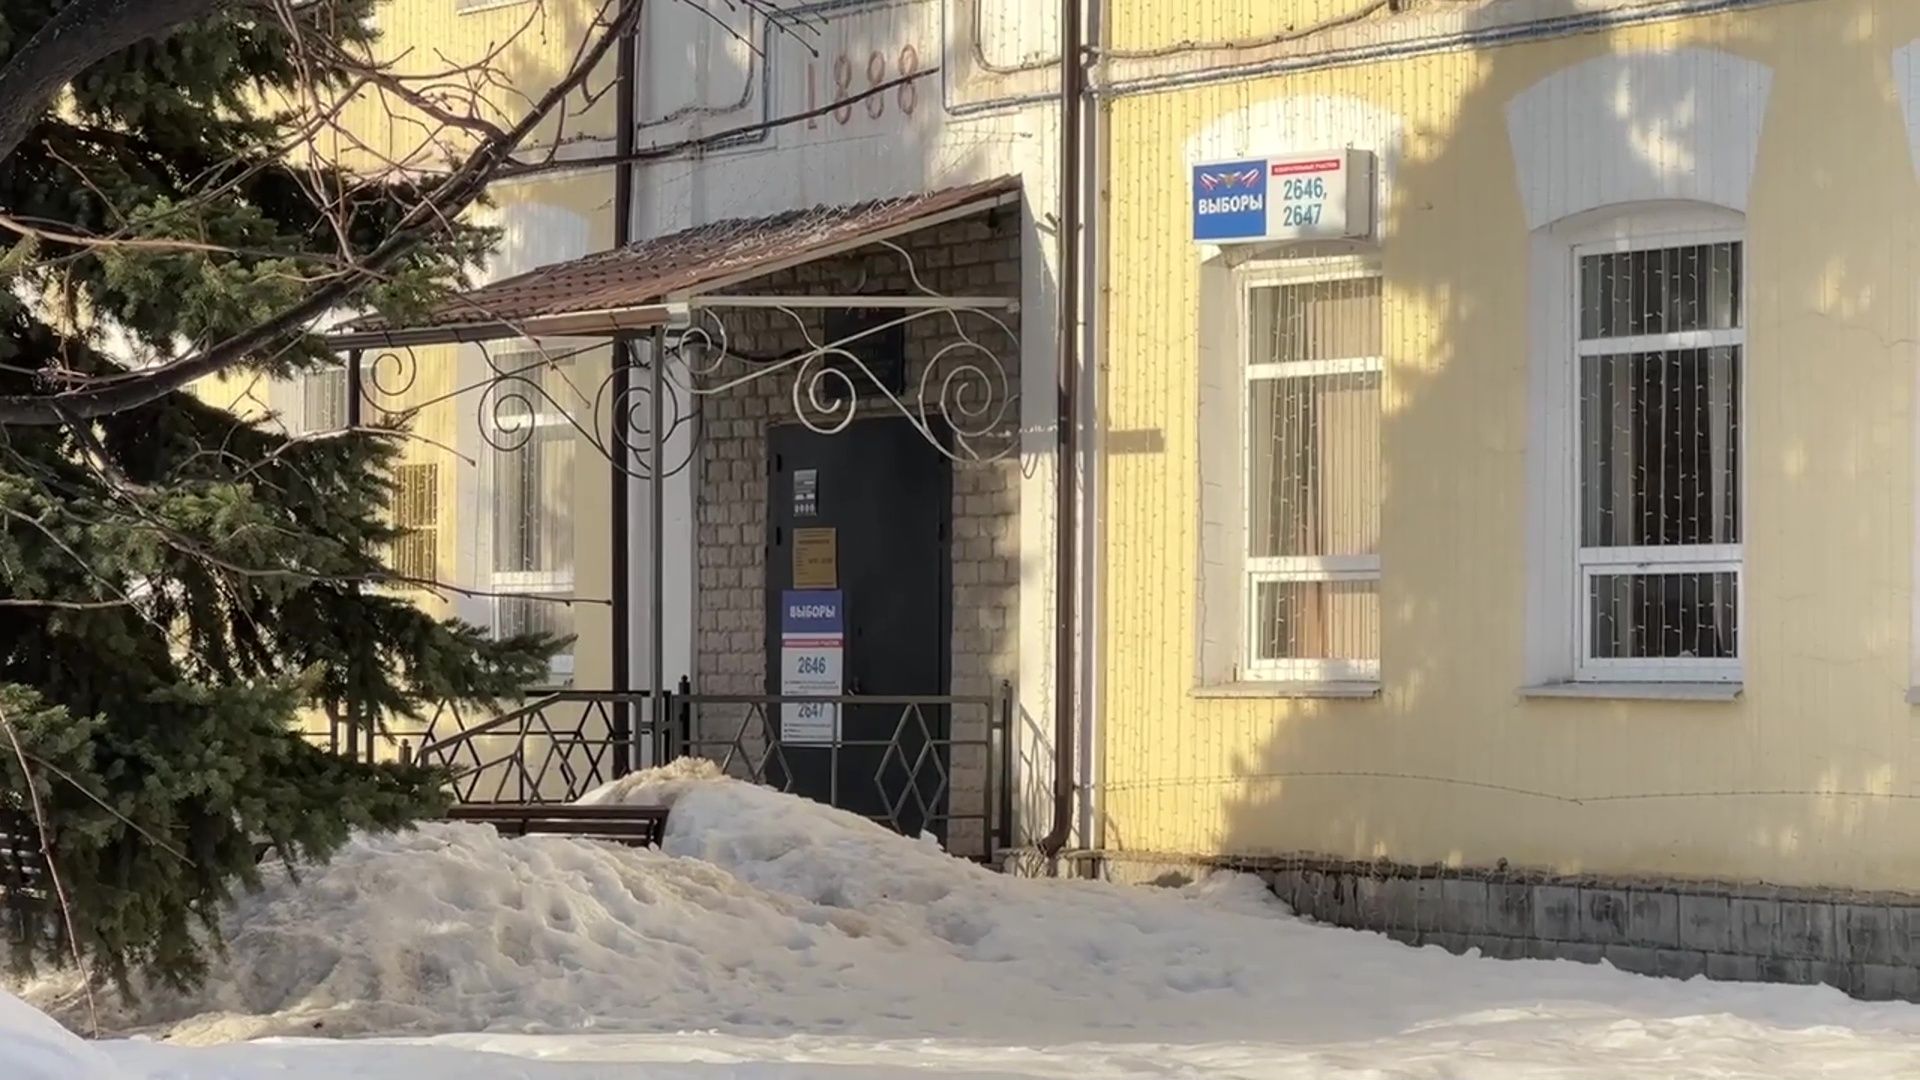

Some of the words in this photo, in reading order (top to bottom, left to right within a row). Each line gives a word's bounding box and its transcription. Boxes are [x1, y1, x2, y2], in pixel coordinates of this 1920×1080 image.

[808, 44, 918, 129] 1888
[1283, 177, 1327, 200] 2646,
[1198, 193, 1263, 215] ВЫБОРЫ
[1283, 203, 1322, 226] 2647
[789, 606, 836, 618] ВЫБОРЫ
[798, 656, 826, 674] 2646
[798, 702, 824, 718] 2647
